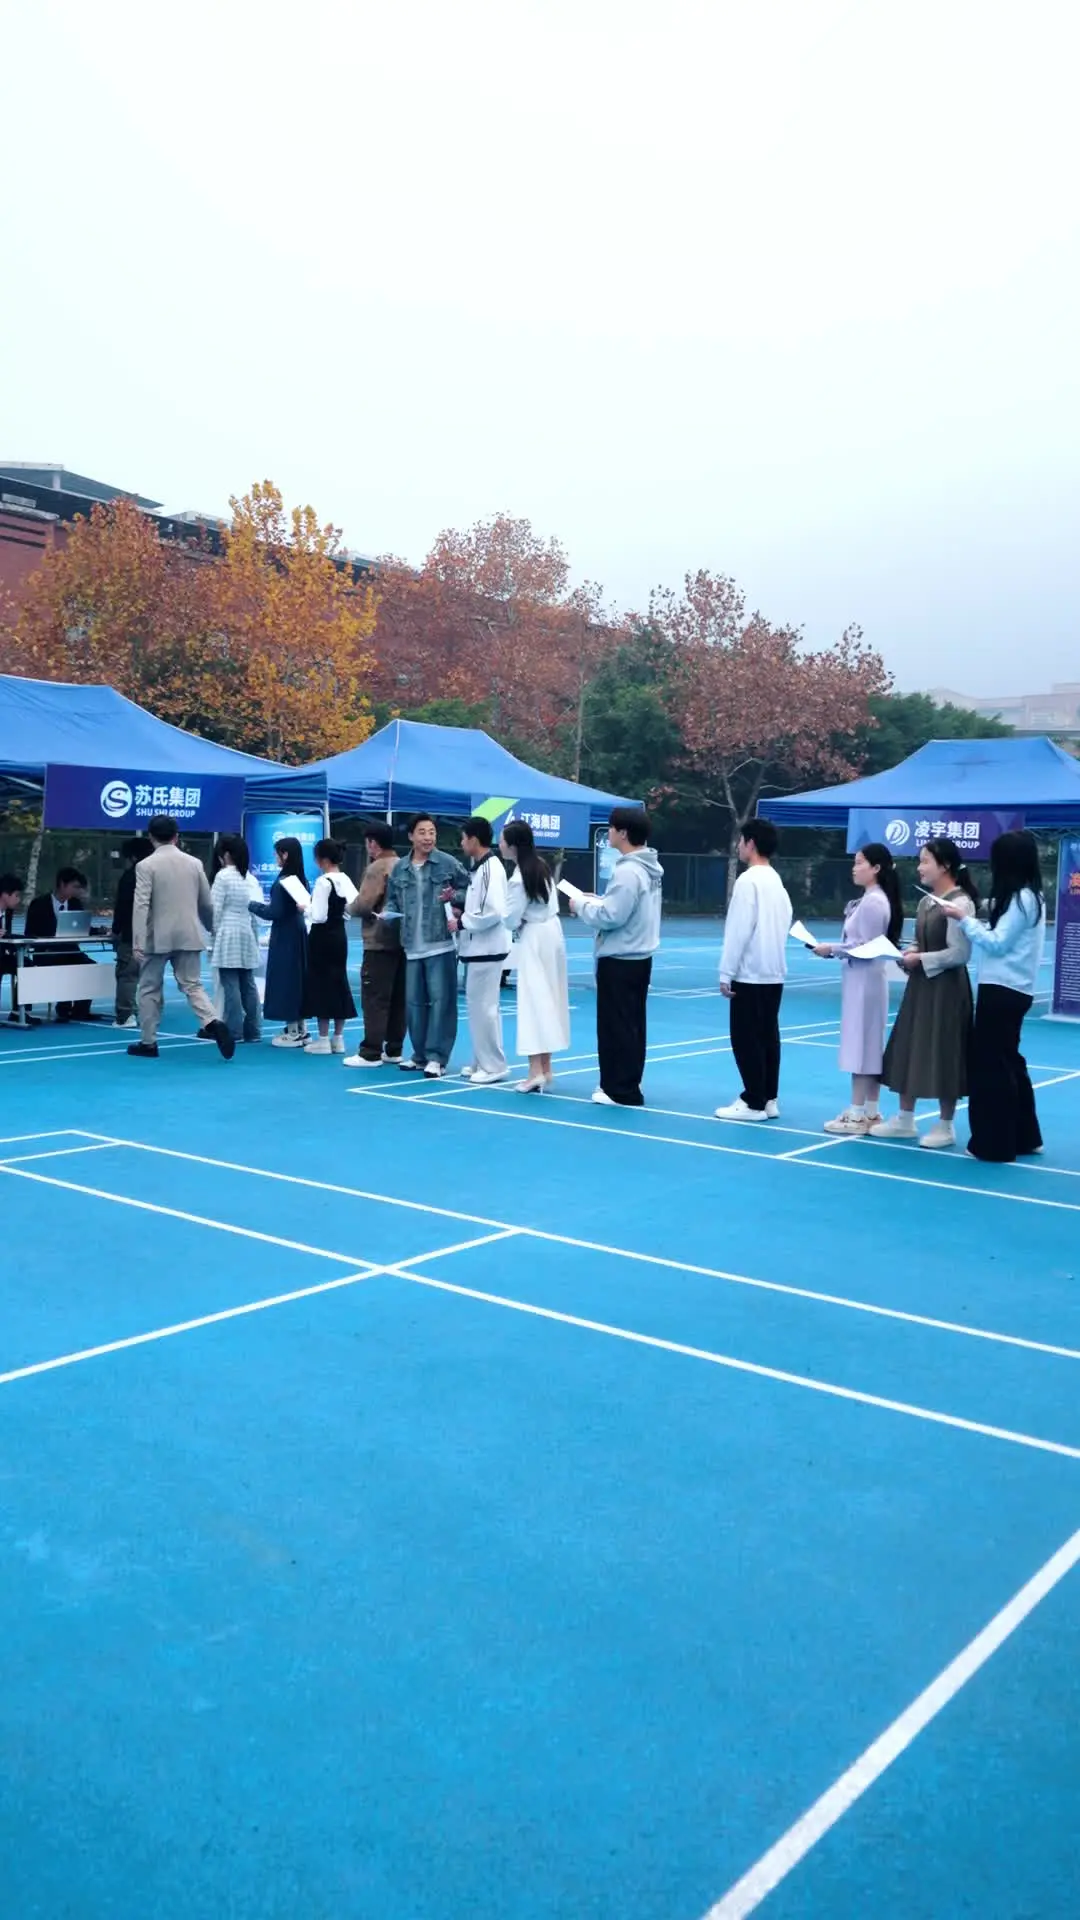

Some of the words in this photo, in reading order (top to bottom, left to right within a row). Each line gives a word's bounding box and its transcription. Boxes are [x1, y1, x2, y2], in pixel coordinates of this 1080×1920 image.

[135, 784, 201, 808] 苏氏集团
[136, 807, 153, 817] SHU
[168, 809, 196, 818] GROUP
[914, 820, 981, 839] 凌宇集团
[954, 840, 981, 849] ROUP
